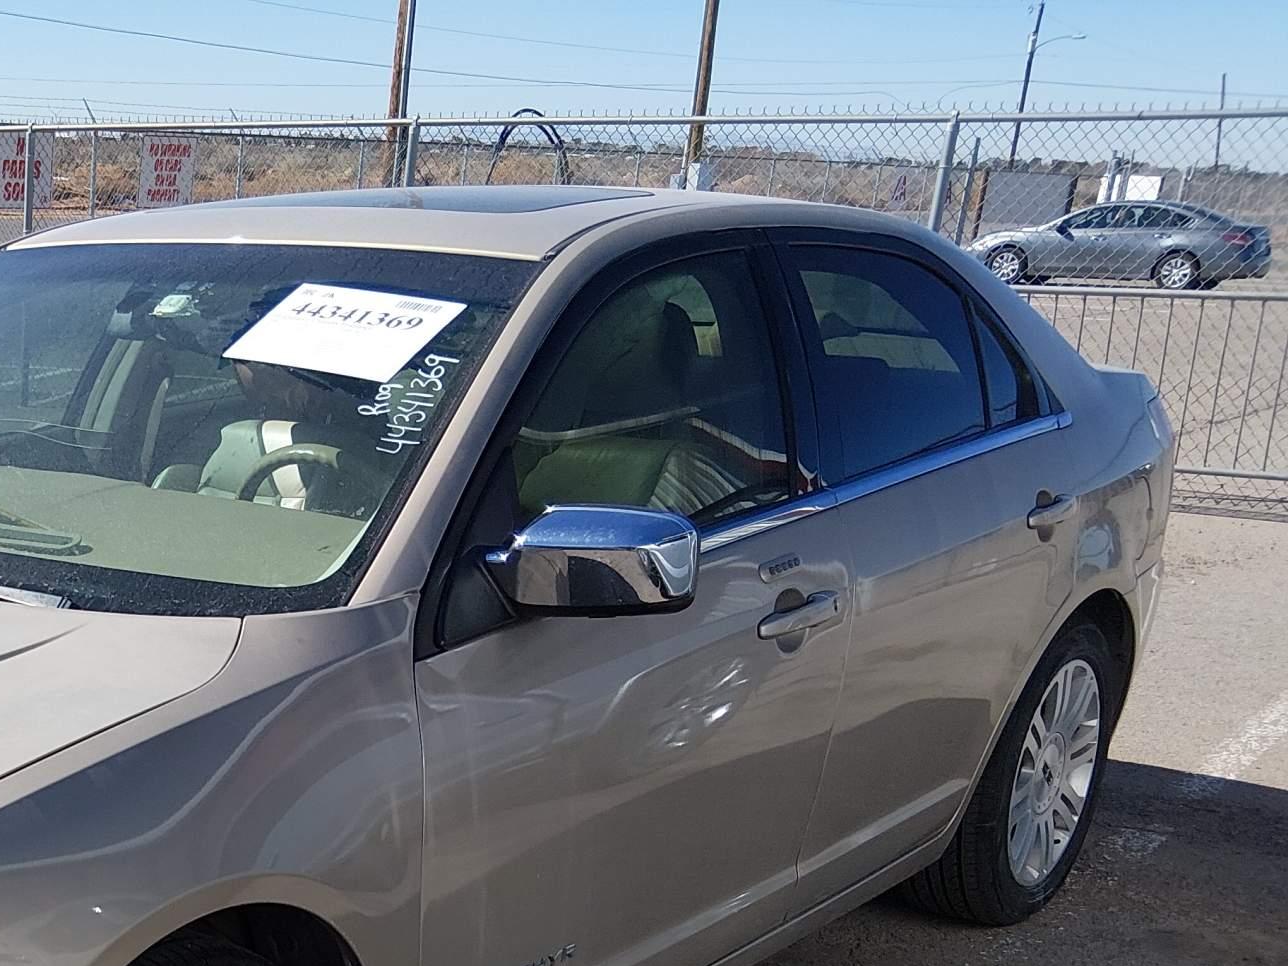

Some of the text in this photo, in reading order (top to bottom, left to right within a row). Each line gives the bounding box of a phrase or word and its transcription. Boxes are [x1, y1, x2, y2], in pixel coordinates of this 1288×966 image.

[2, 159, 42, 180] PARS
[3, 182, 26, 202] SOL
[289, 302, 424, 331] 44341369
[375, 353, 461, 454] 44341369
